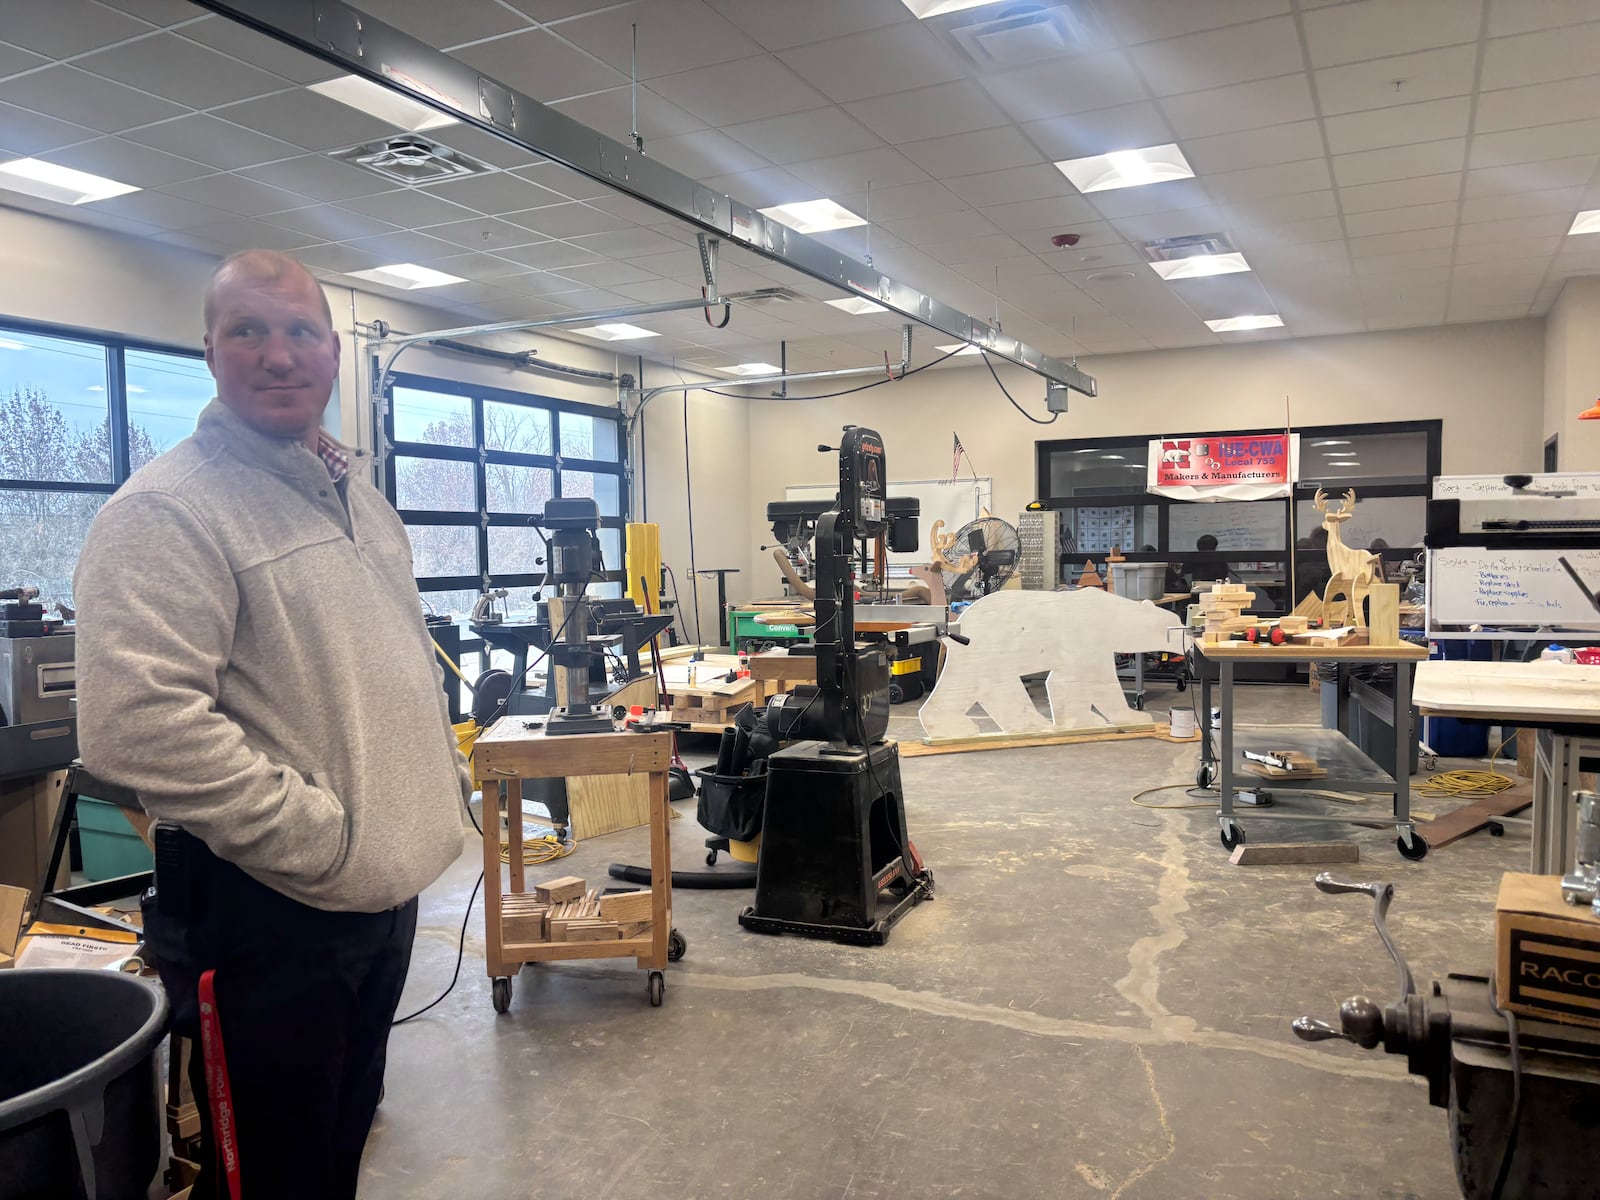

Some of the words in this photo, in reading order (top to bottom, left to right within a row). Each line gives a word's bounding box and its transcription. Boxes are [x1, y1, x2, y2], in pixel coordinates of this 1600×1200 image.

[1219, 440, 1283, 457] IUE-CWA
[1164, 472, 1199, 480] Makers
[1201, 472, 1208, 480] &
[1211, 471, 1280, 480] Manufacturers
[218, 1101, 236, 1174] Northridge
